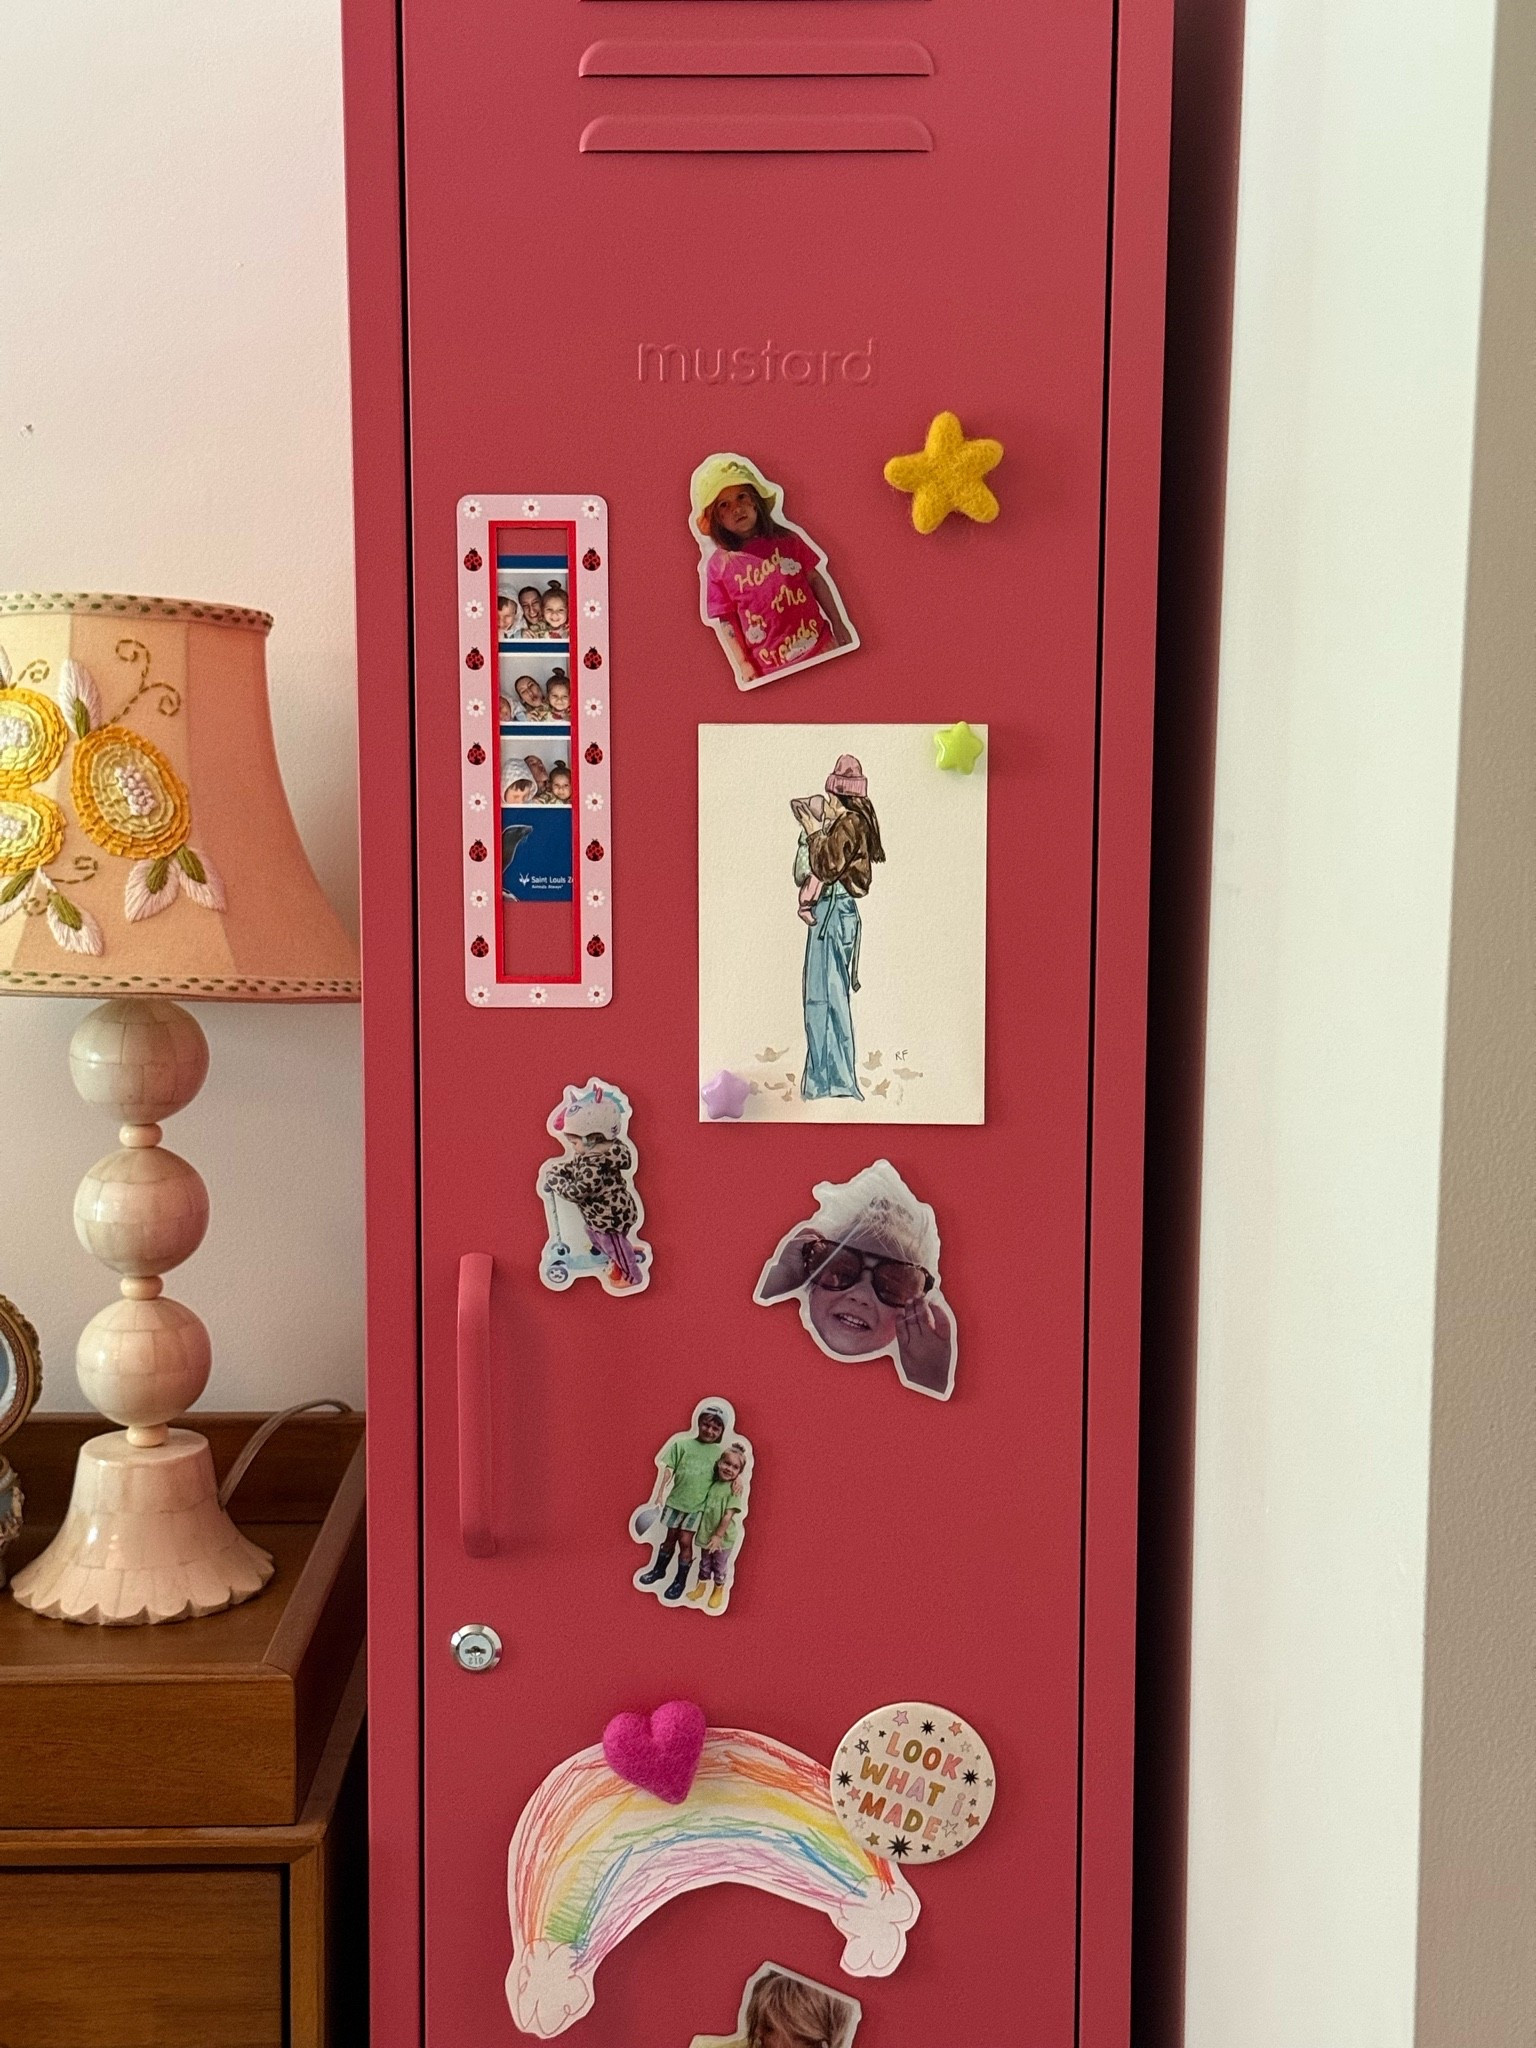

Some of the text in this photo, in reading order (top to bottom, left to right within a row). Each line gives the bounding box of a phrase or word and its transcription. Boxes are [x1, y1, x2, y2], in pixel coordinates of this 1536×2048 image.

[638, 338, 874, 386] mustard
[735, 547, 781, 593] Head
[771, 585, 806, 613] the
[531, 876, 548, 884] Saint
[549, 876, 566, 884] Louis
[885, 1730, 963, 1780] LOOK
[859, 1755, 946, 1807] WHAT
[858, 1791, 943, 1841] MADE
